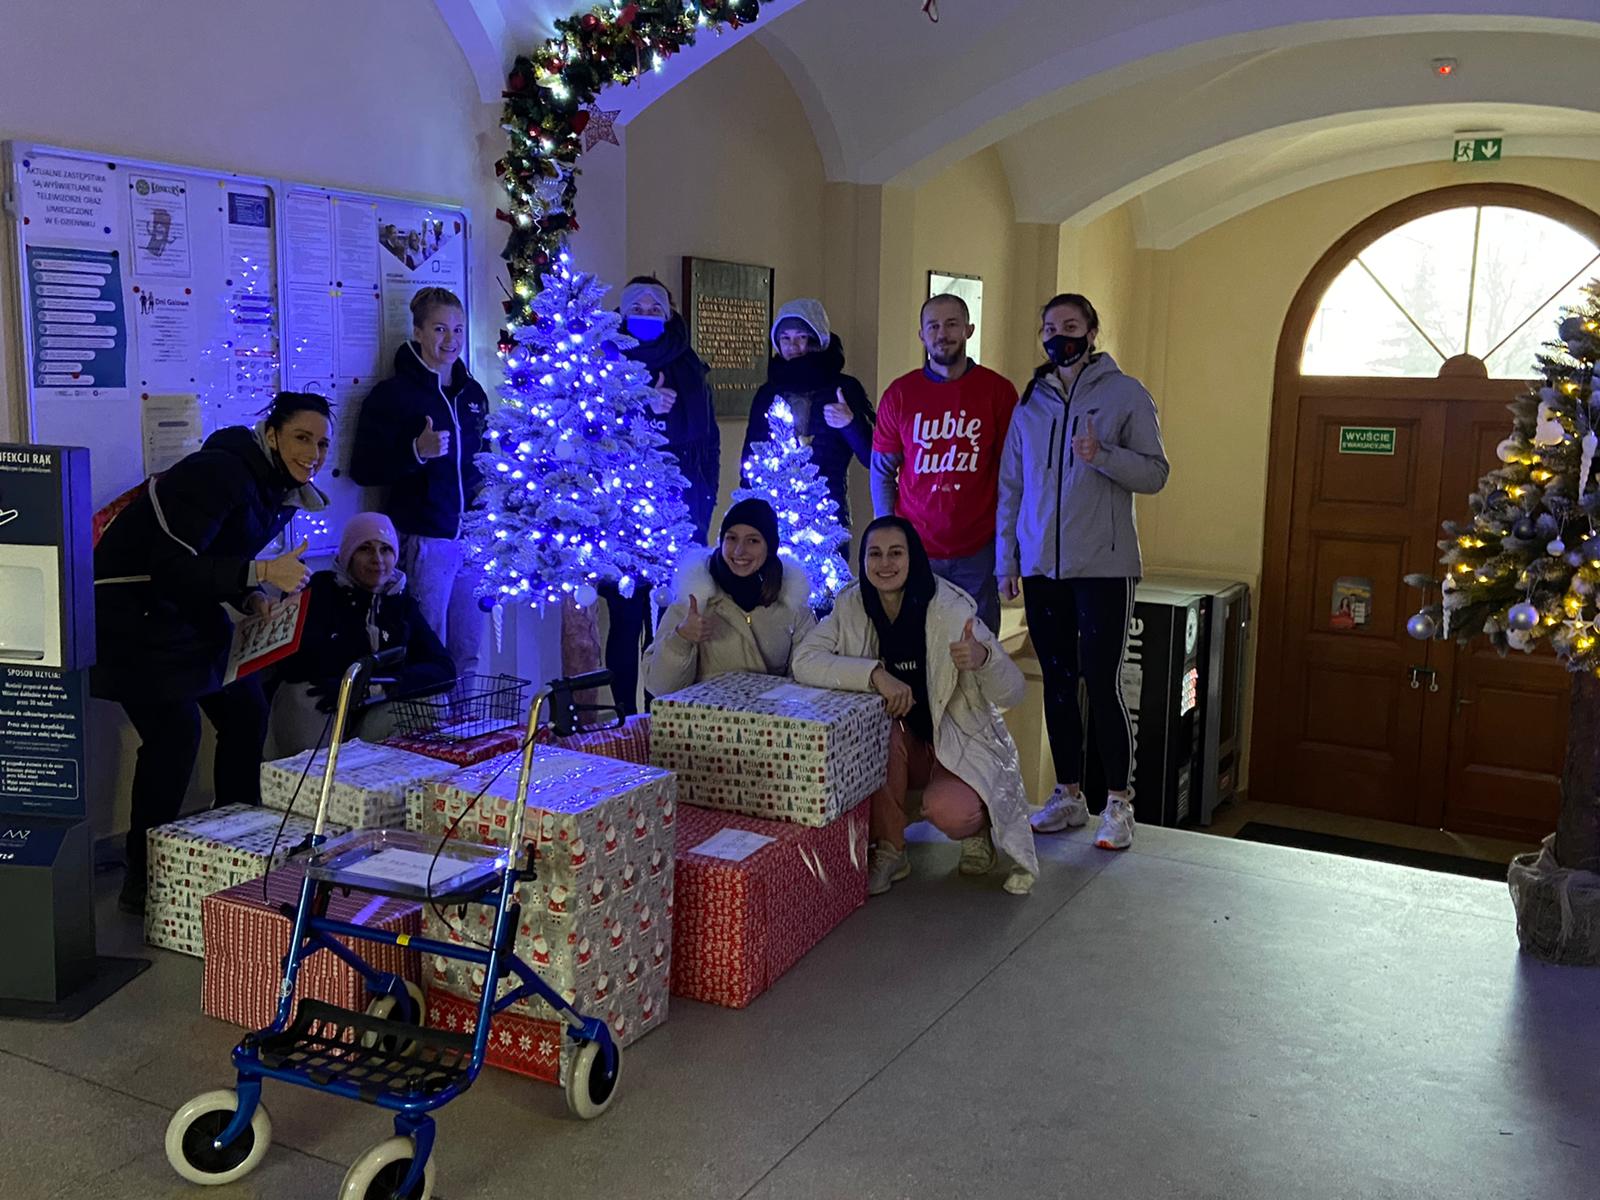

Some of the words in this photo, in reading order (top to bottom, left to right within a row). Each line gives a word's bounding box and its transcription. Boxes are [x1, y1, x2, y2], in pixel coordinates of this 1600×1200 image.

[913, 409, 981, 450] Lubię
[1345, 431, 1390, 442] WYJŚCIE
[0, 452, 30, 463] FEKCJI
[32, 454, 51, 467] RĄK
[914, 445, 980, 474] ludzi
